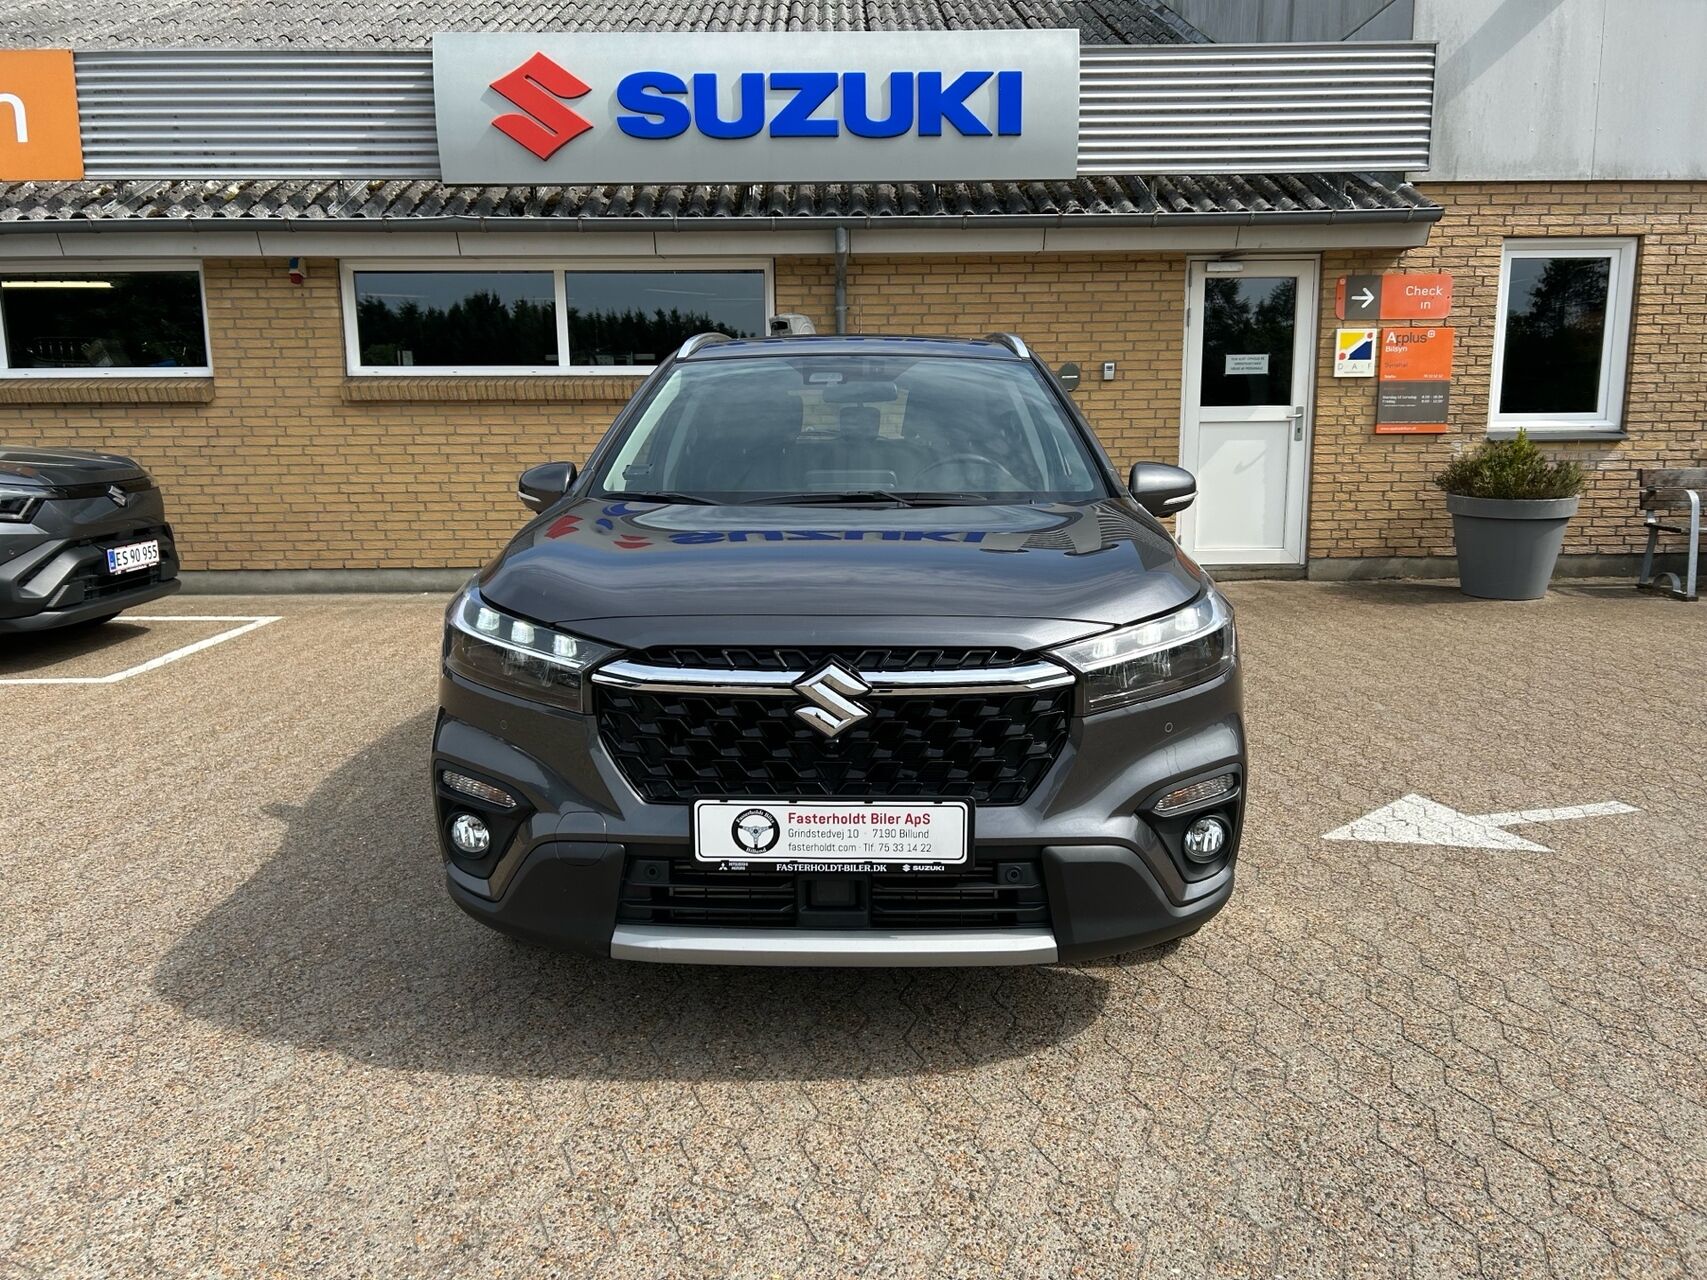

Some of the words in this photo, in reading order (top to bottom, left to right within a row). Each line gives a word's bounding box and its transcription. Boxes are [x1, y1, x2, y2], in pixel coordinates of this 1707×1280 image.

[616, 71, 1023, 140] SUZUKI
[1405, 285, 1444, 297] Check
[1420, 301, 1432, 310] in
[1385, 345, 1408, 354] Bilsyn
[116, 550, 129, 567] ES
[130, 548, 141, 564] 90
[142, 544, 158, 561] 955
[787, 812, 867, 825] Fasterholdt
[870, 813, 901, 825] Biler
[904, 813, 931, 827] ApS
[787, 827, 845, 841] Grindstedvej
[847, 829, 859, 839] 10
[872, 829, 897, 839] 7190
[899, 829, 930, 839] Billund
[863, 842, 876, 852] Tlf.
[878, 843, 890, 853] 75
[892, 843, 904, 853] 33
[907, 843, 918, 853] 14
[920, 843, 932, 853] 22
[776, 864, 887, 872] FASTERHOLDT-BILER.DK
